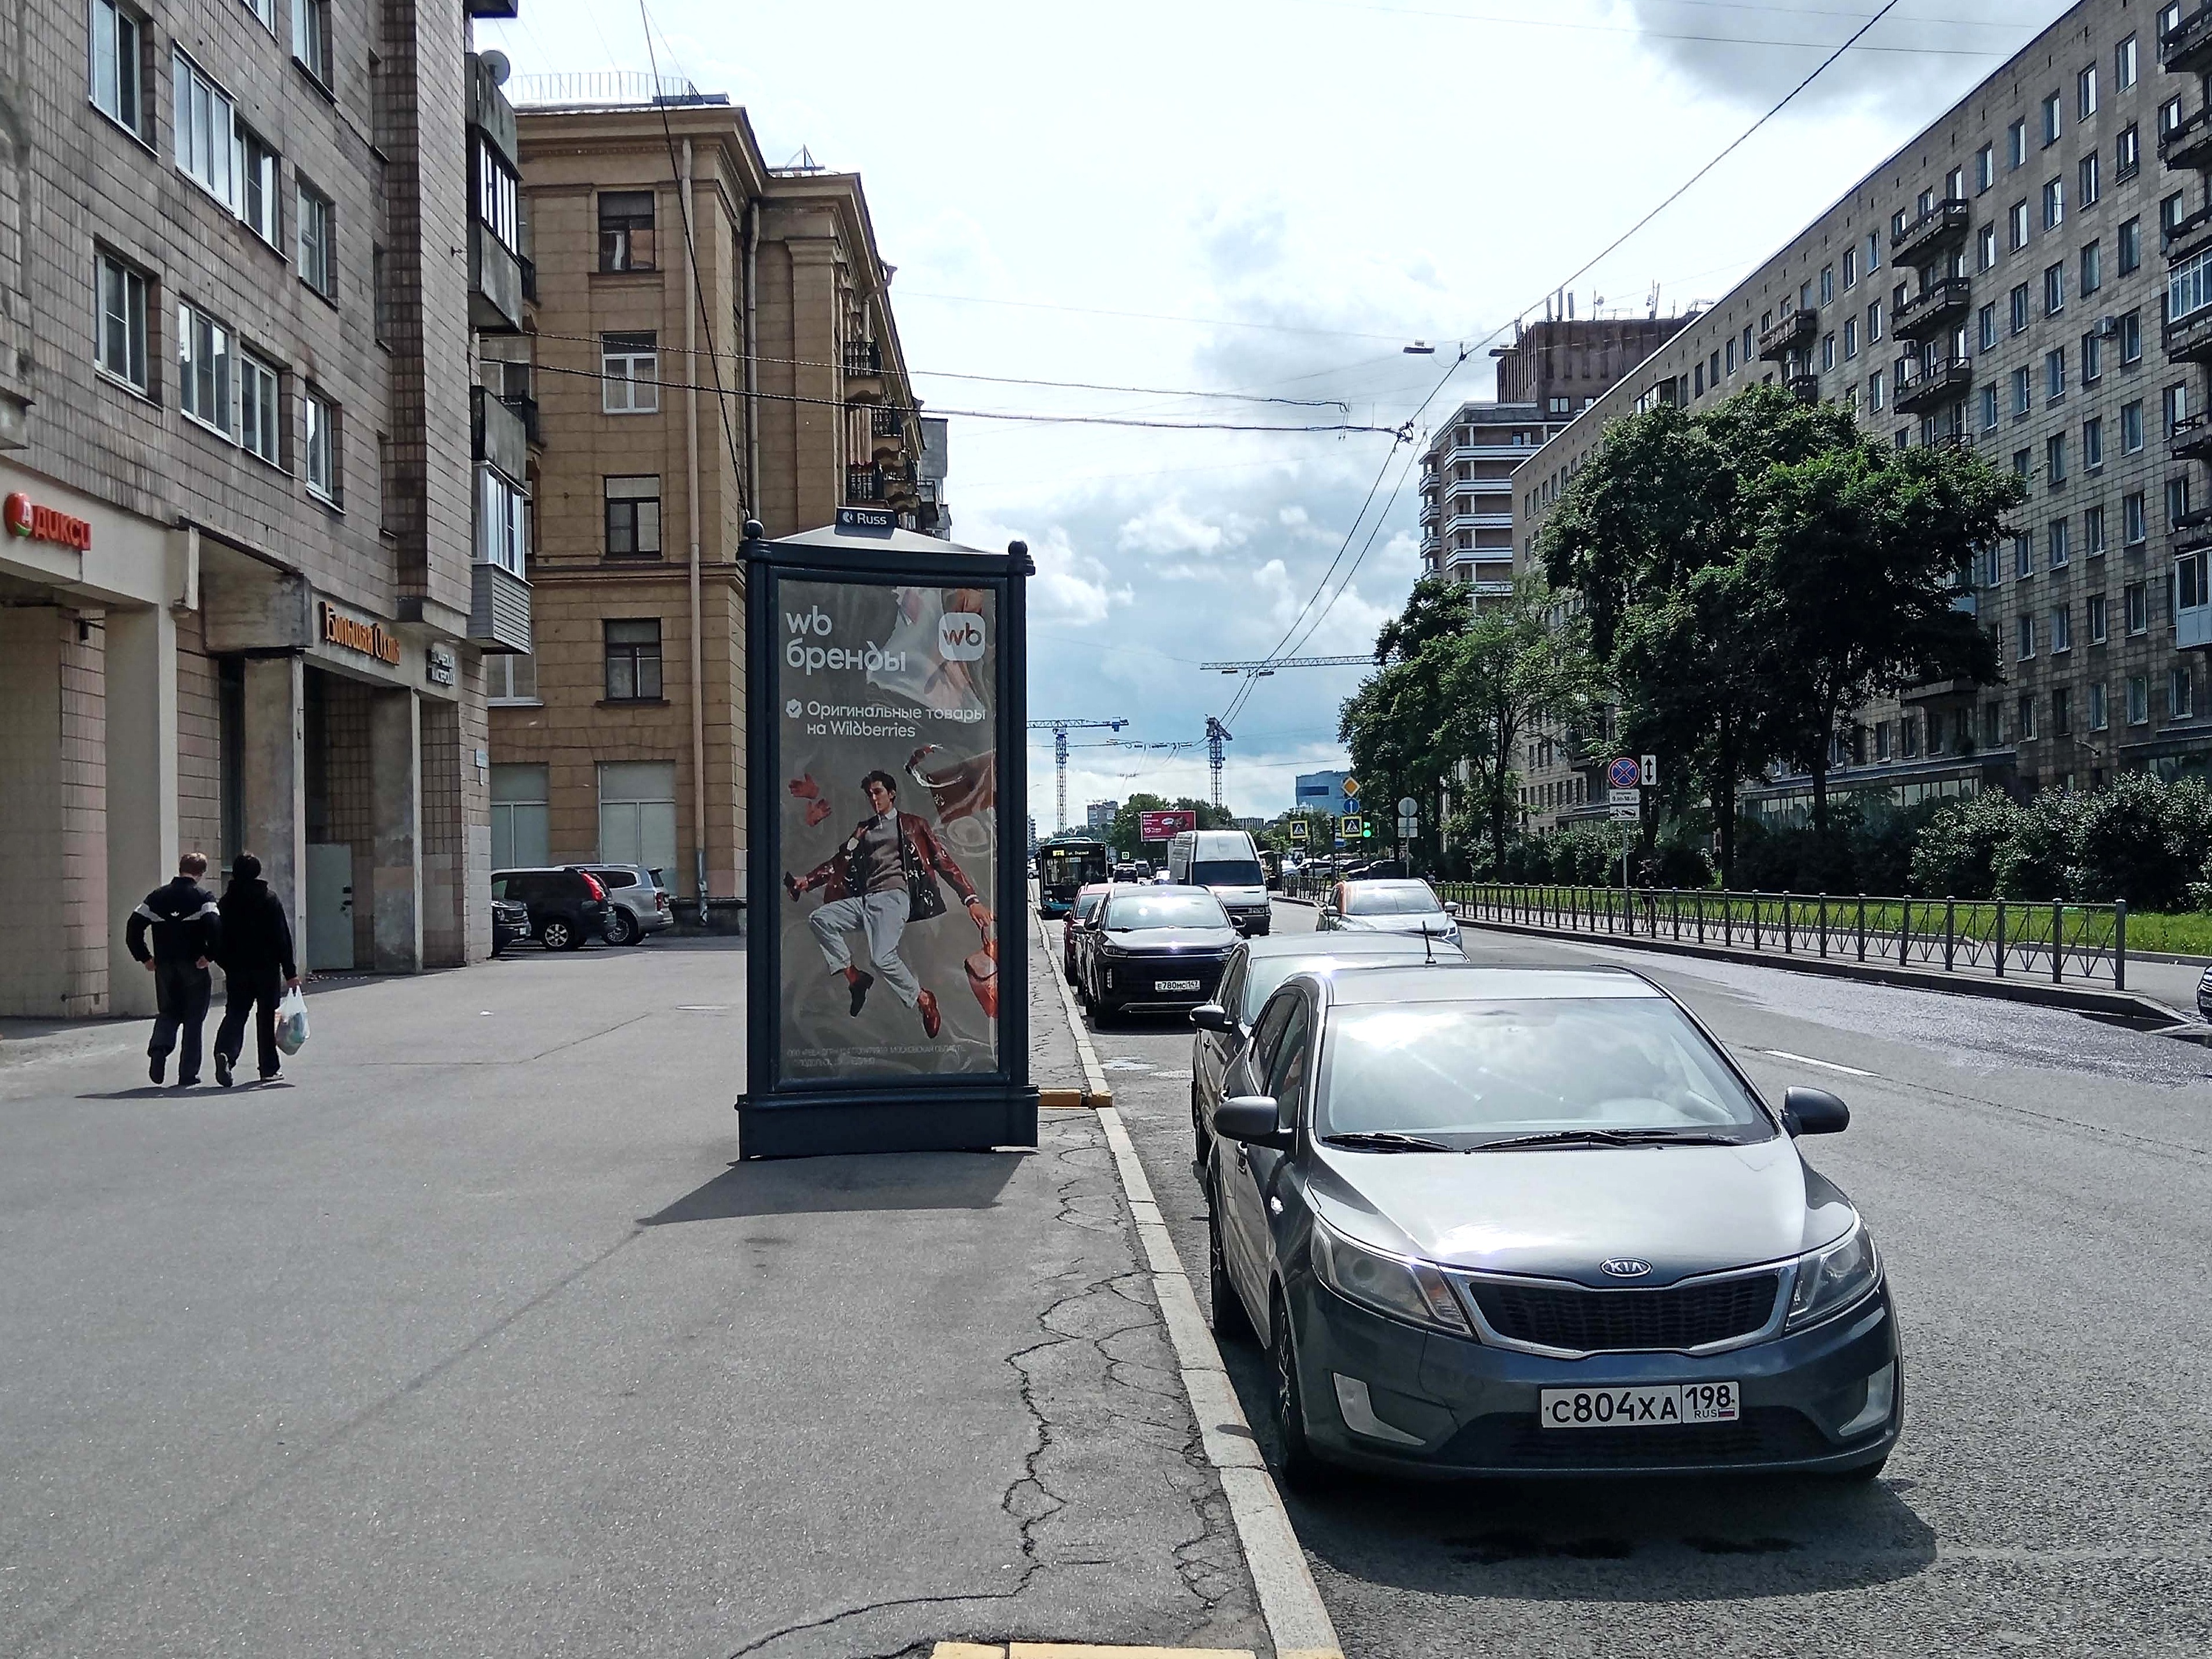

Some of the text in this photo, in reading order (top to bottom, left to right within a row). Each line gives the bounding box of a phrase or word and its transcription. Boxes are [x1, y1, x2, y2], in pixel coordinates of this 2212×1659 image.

[857, 512, 887, 525] Russ
[786, 605, 833, 636] wb
[942, 622, 983, 646] wb
[786, 637, 906, 675] бренды
[806, 701, 985, 722] Оригинальные товары
[806, 721, 916, 737] на Wildberries
[1609, 1262, 1645, 1273] KIA
[1551, 1385, 1731, 1423] С804ХА 198
[1694, 1409, 1717, 1418] RUS
